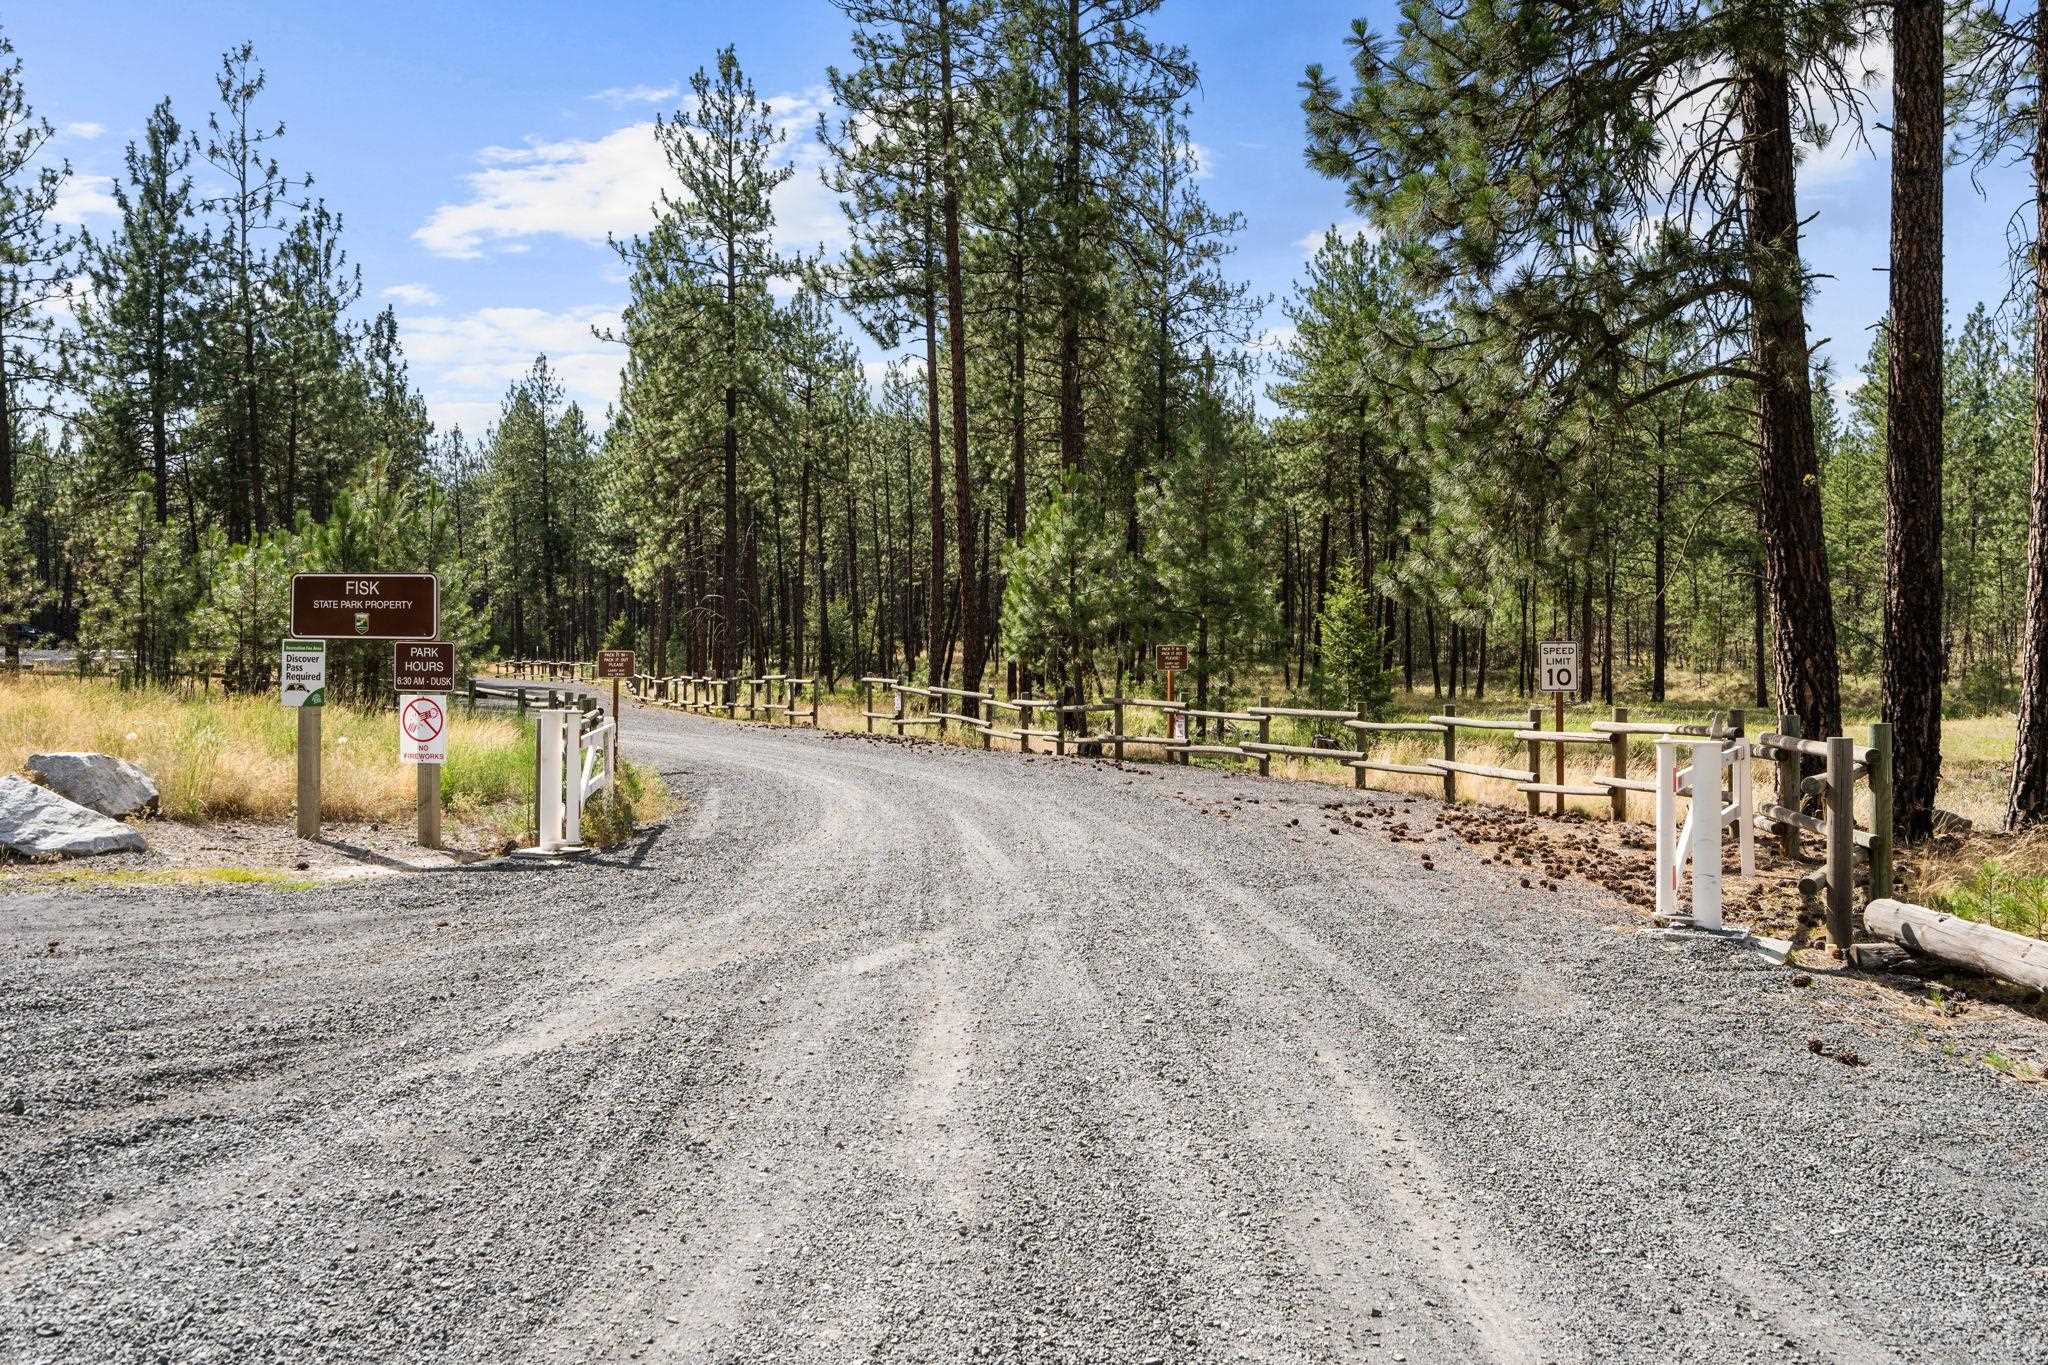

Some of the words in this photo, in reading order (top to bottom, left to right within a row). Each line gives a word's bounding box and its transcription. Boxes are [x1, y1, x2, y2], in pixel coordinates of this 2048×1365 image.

[345, 581, 380, 595] FISK
[313, 600, 338, 609] STATE
[340, 600, 363, 609] PARK
[365, 600, 413, 609] PROPERTY
[410, 647, 439, 657] PARK
[1543, 647, 1575, 655] SPEED
[286, 654, 320, 663] Discover
[286, 663, 304, 671] Pass
[405, 661, 444, 671] HOURS
[286, 672, 321, 682] Required
[396, 676, 412, 685] 6:30
[413, 676, 425, 685] AM
[430, 677, 452, 686] DUSK
[1547, 668, 1572, 686] 10
